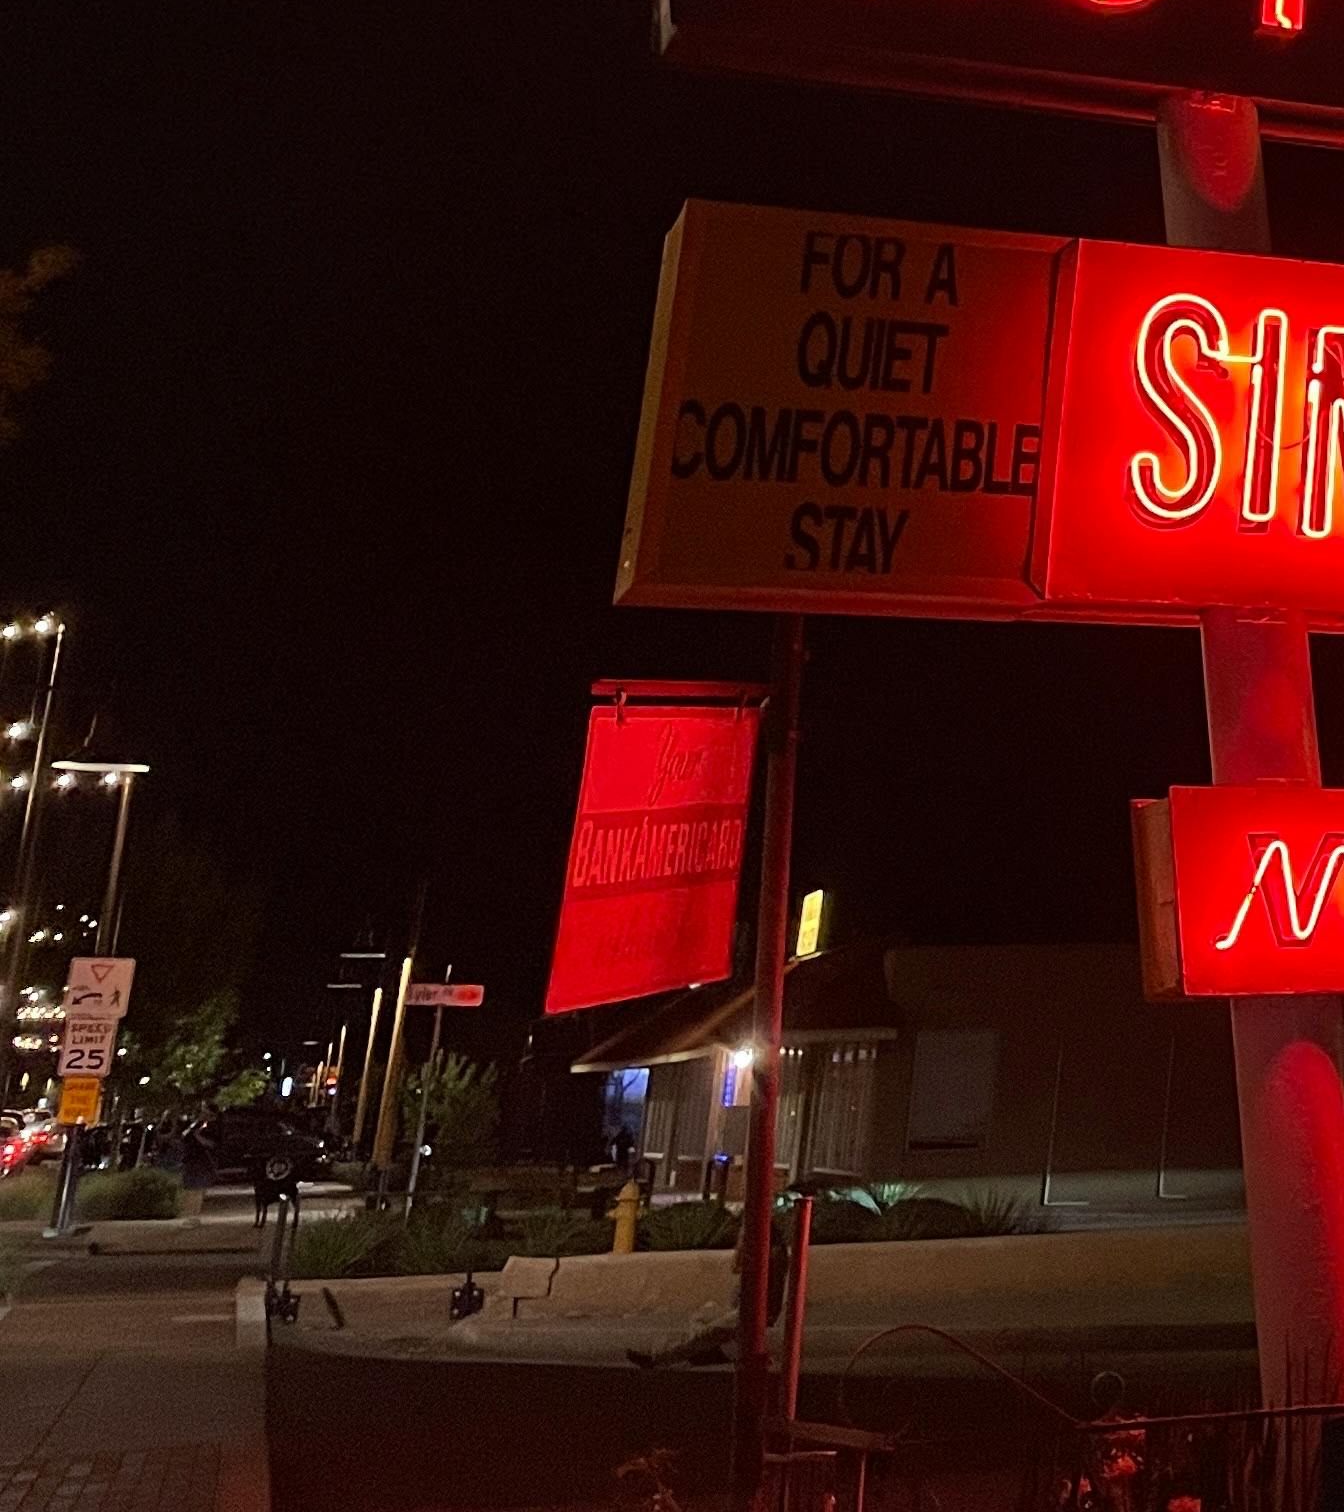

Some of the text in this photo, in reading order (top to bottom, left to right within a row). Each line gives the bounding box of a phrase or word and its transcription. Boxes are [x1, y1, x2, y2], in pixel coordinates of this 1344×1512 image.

[802, 229, 960, 309] FOR A
[798, 309, 949, 394] QUIET
[669, 398, 1042, 493] COMFORTABLE
[785, 500, 910, 575] STAY
[65, 1048, 105, 1070] 25
[71, 1022, 113, 1034] SPEED
[71, 1034, 106, 1045] LIMIT
